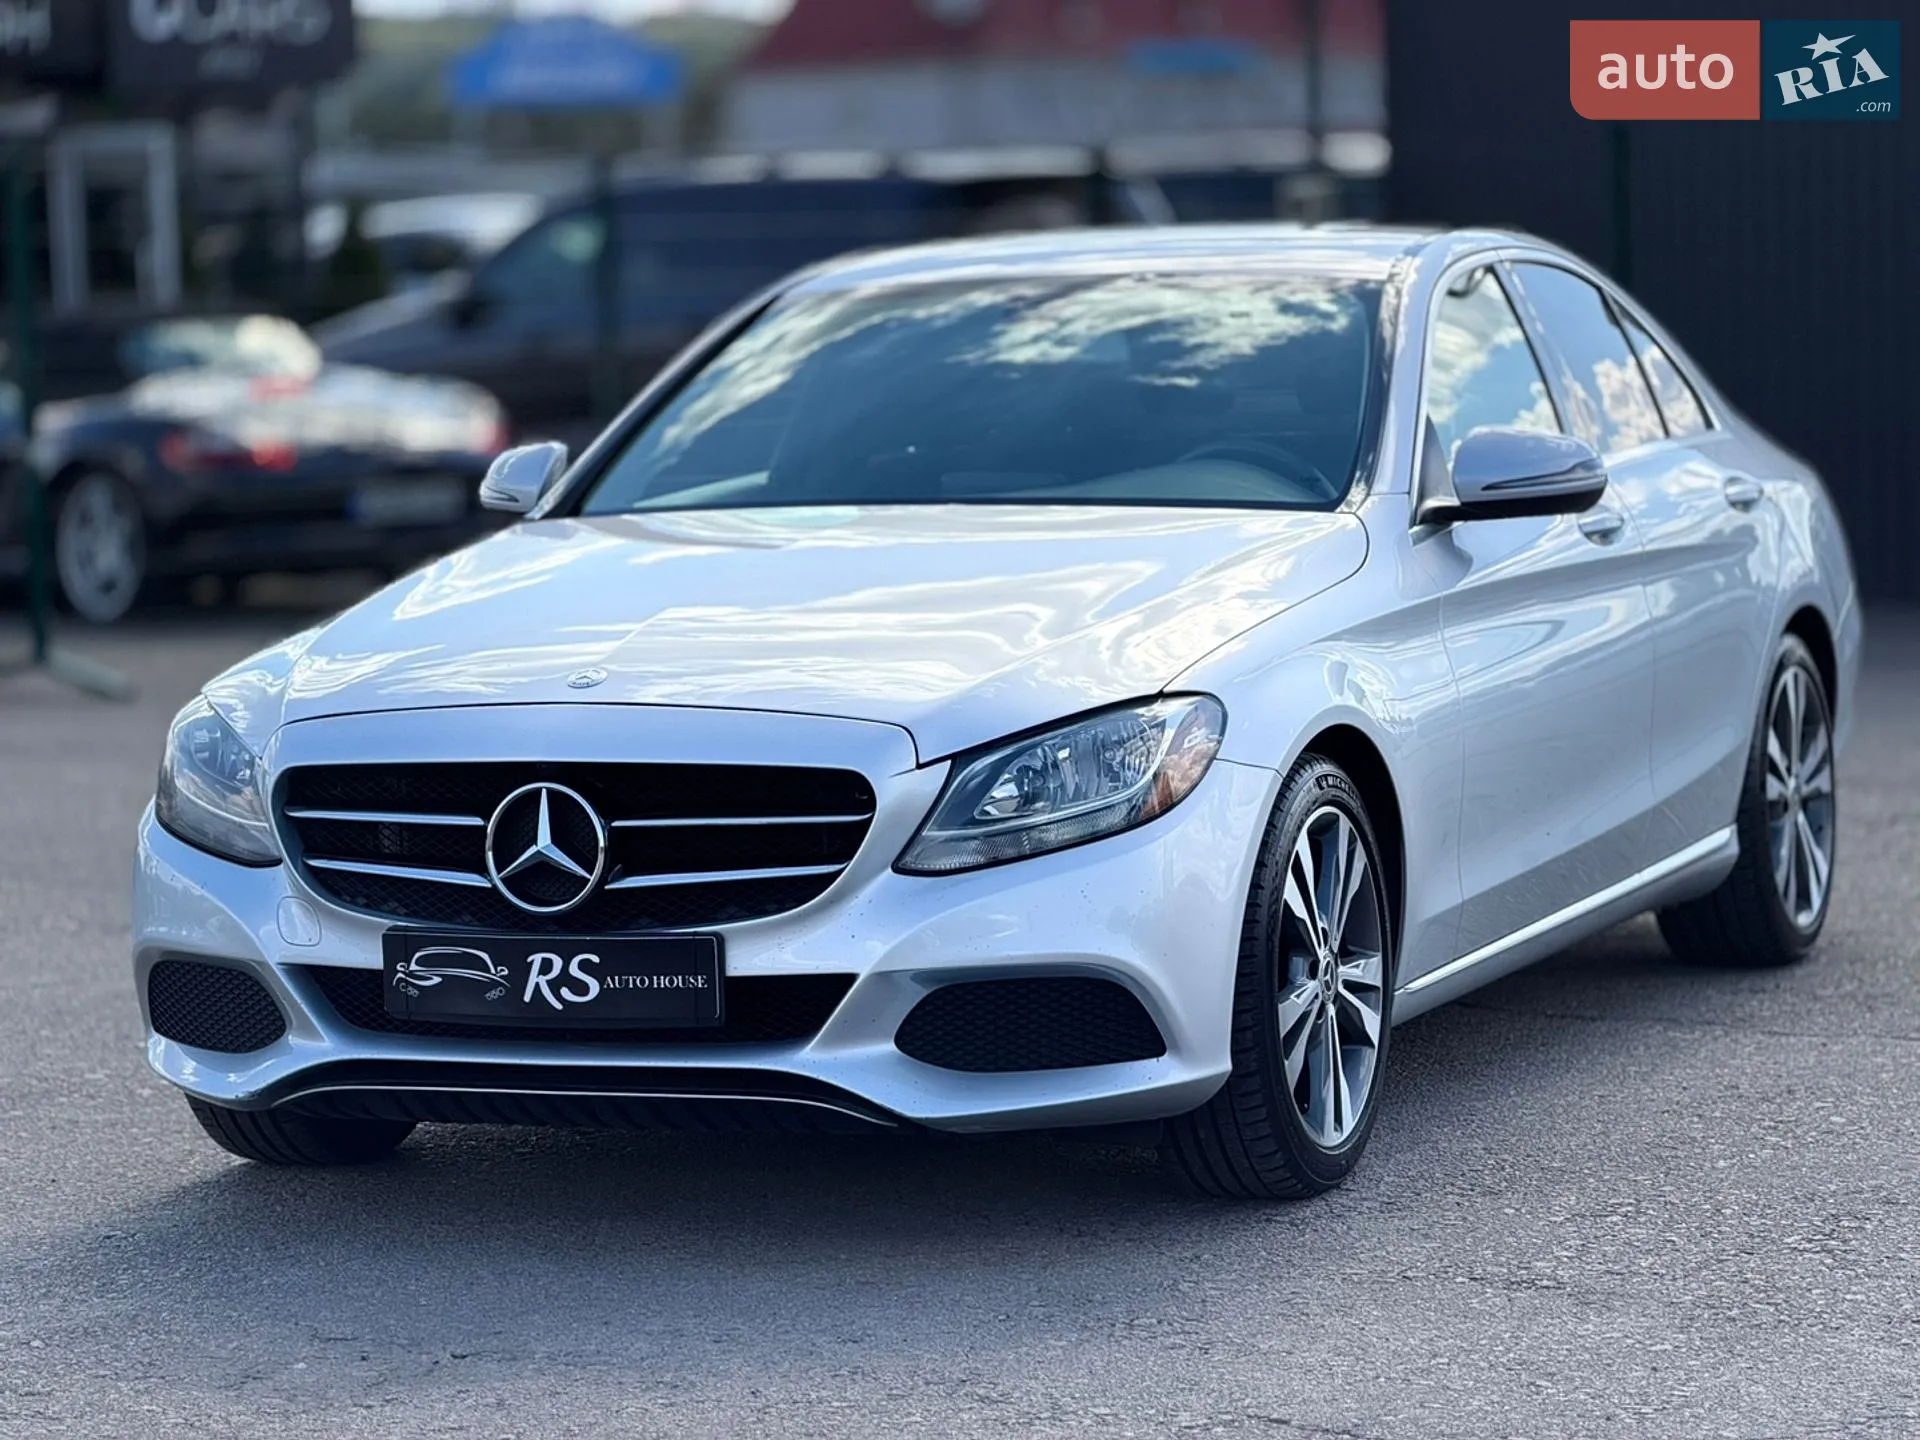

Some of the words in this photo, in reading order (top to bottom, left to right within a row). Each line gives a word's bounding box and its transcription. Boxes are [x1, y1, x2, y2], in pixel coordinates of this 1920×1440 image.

[524, 952, 600, 1010] RS
[603, 975, 648, 989] AUTO
[652, 975, 708, 988] HOUSE
